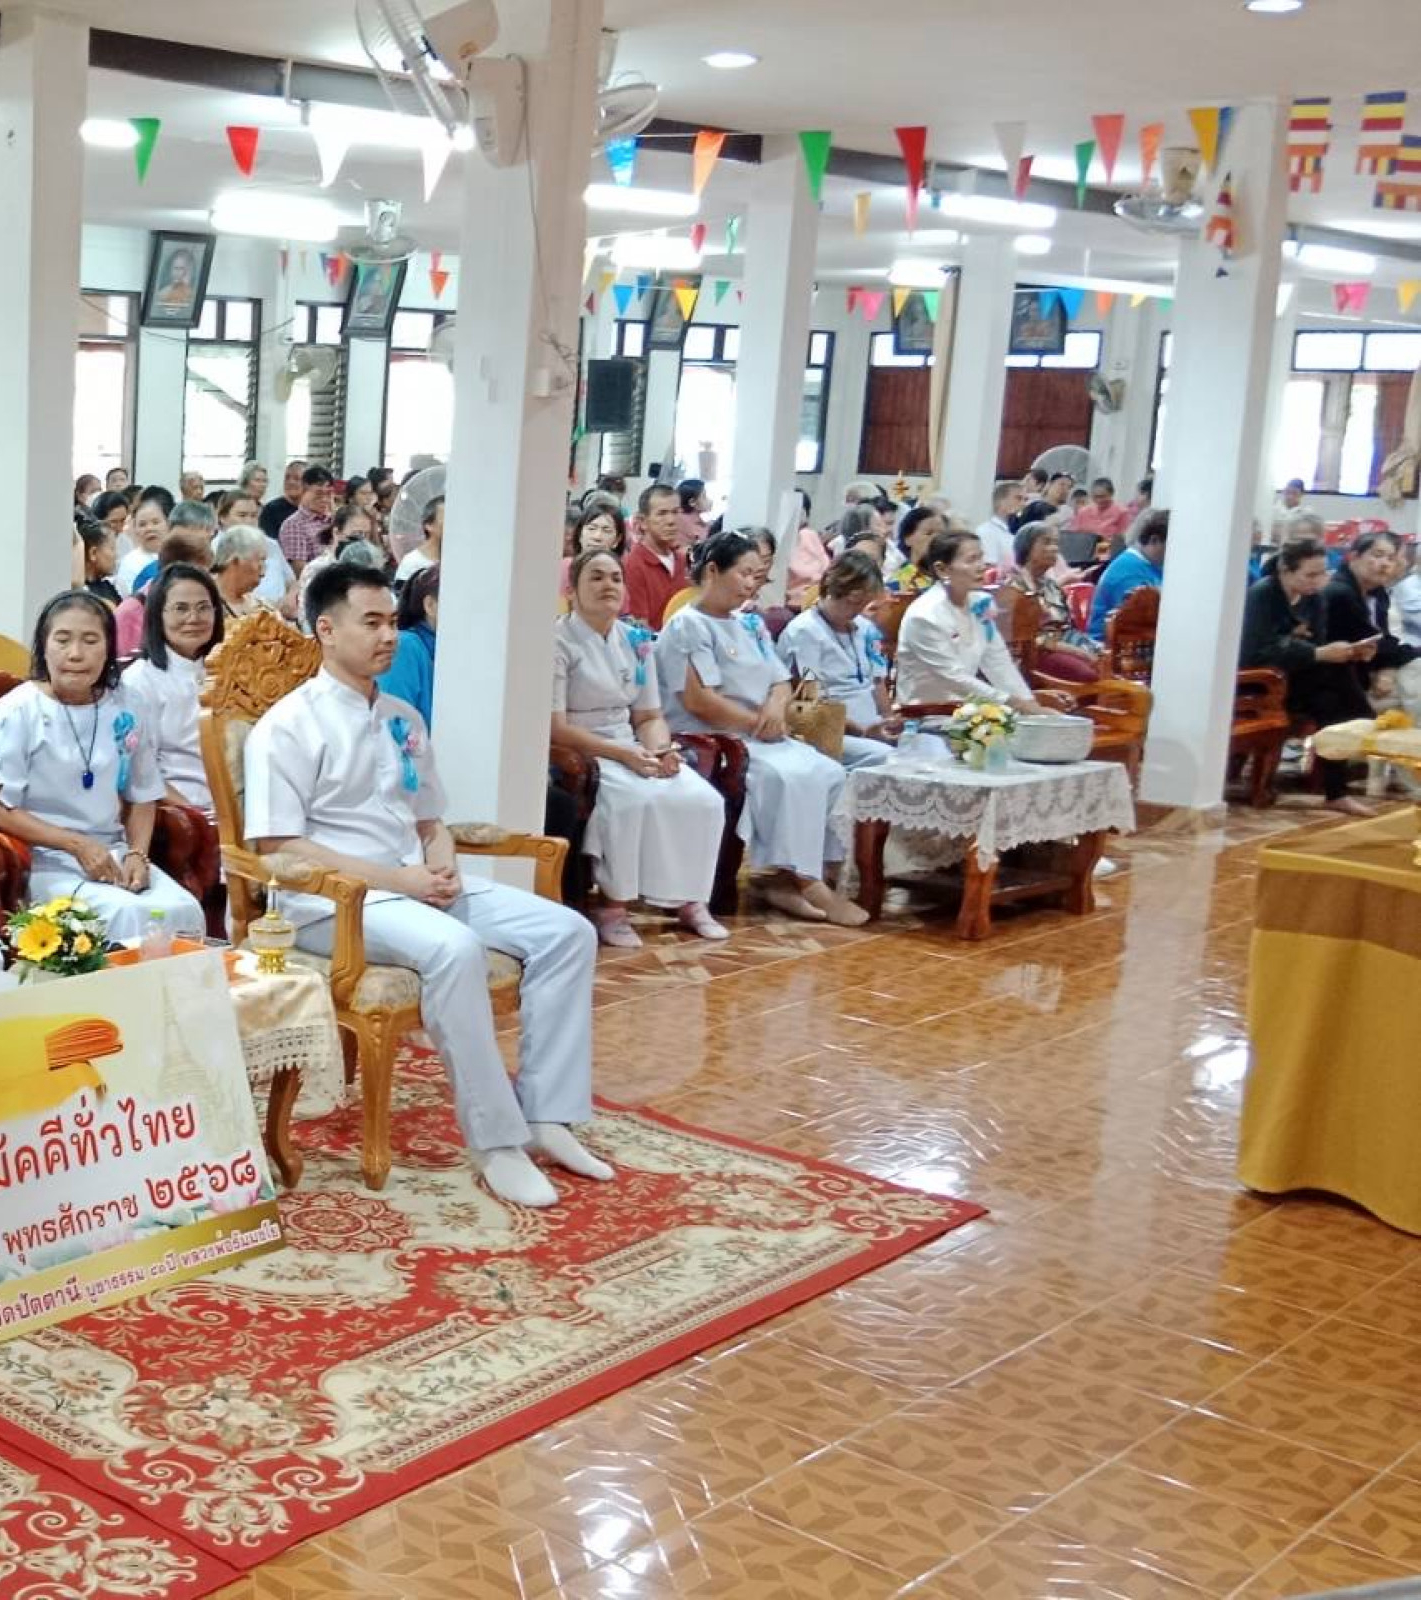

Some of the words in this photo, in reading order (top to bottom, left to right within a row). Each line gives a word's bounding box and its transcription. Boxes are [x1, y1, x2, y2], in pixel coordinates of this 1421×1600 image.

[2, 1193, 139, 1266] พุทธศักราช
[145, 1149, 257, 1209] ๒๕๖๘
